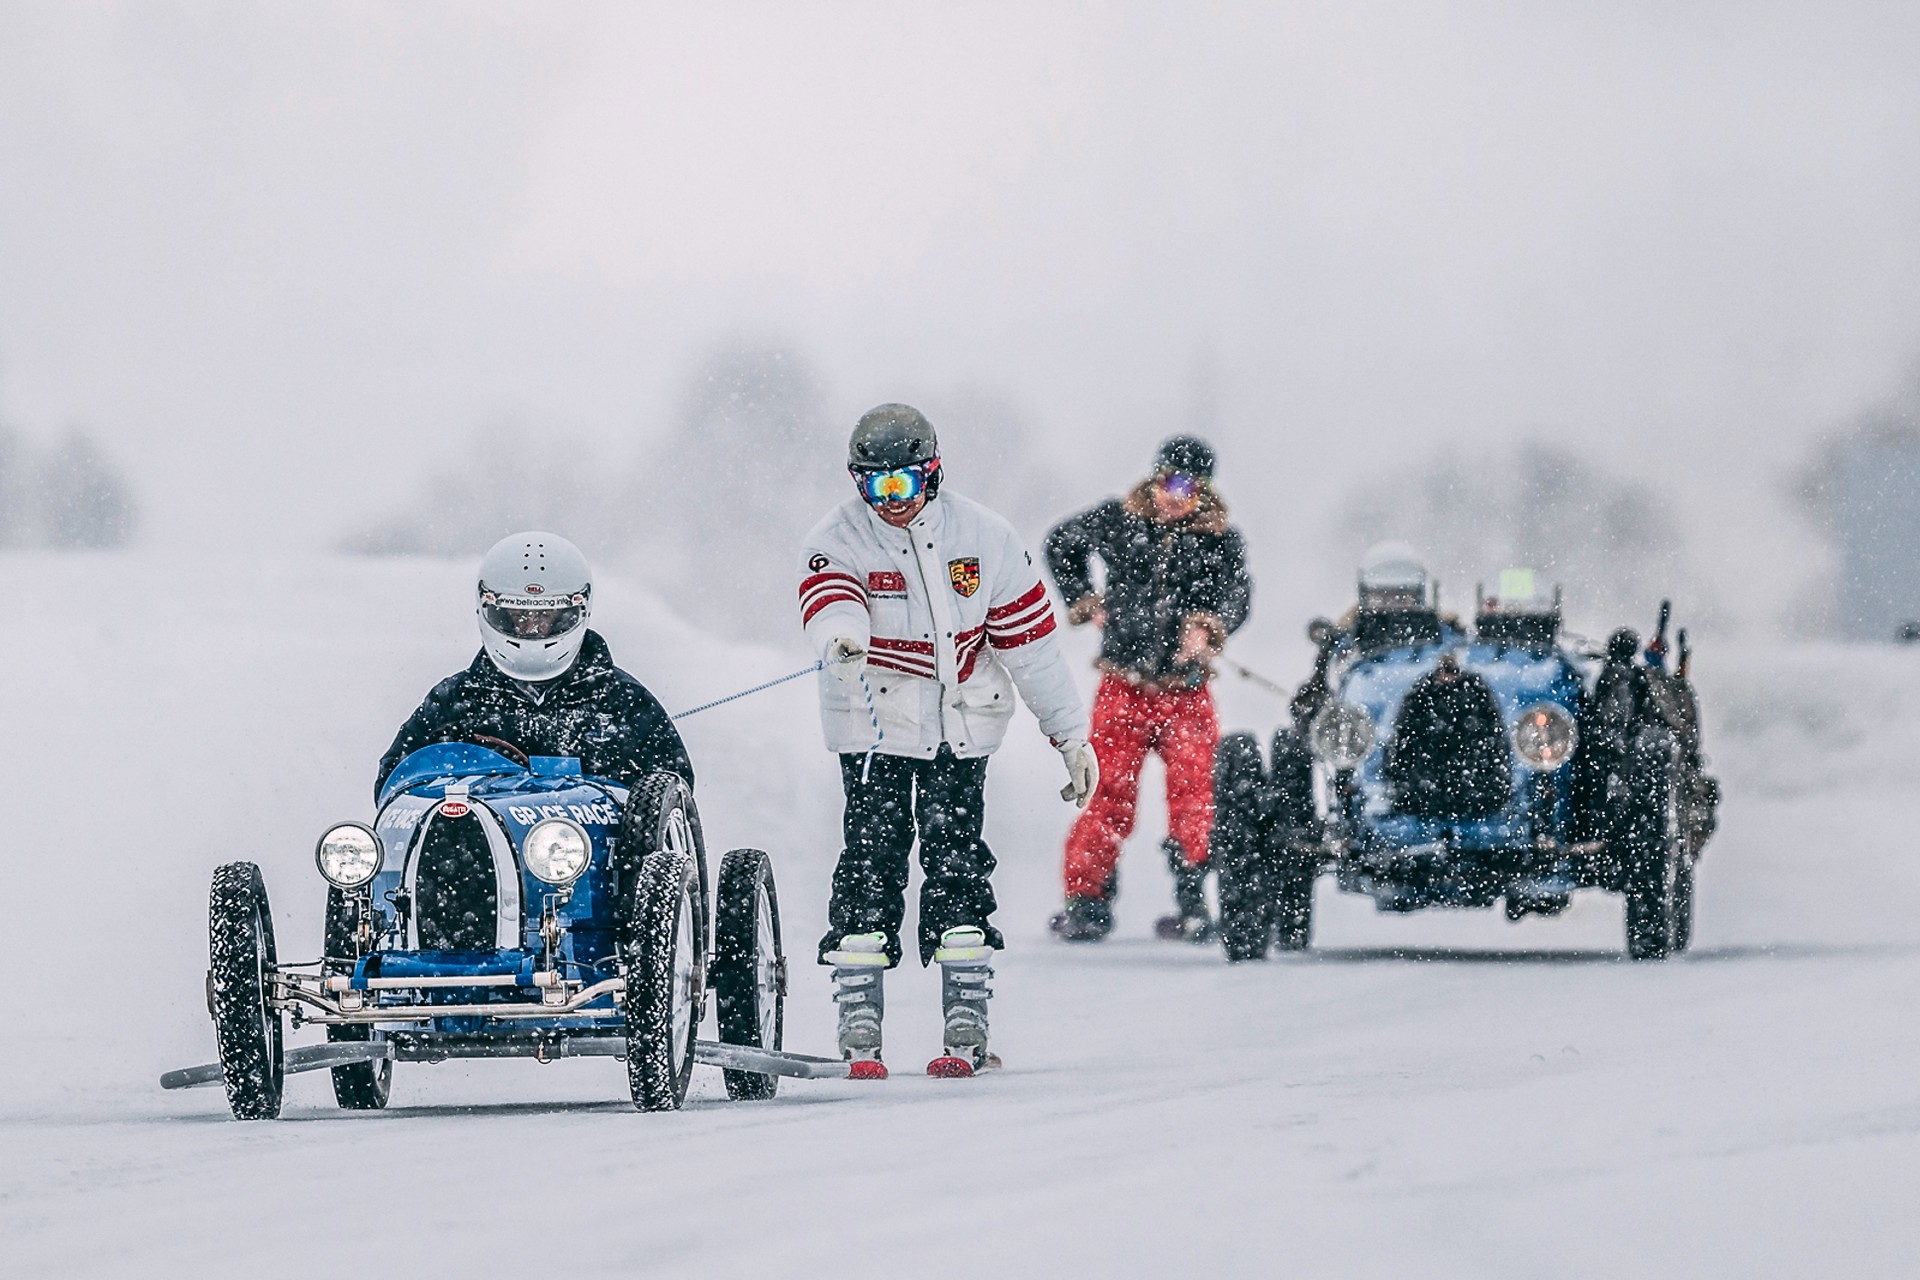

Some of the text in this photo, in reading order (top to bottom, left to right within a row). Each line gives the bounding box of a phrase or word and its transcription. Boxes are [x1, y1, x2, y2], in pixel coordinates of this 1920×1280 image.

[508, 803, 620, 826] GP ICE RACE
